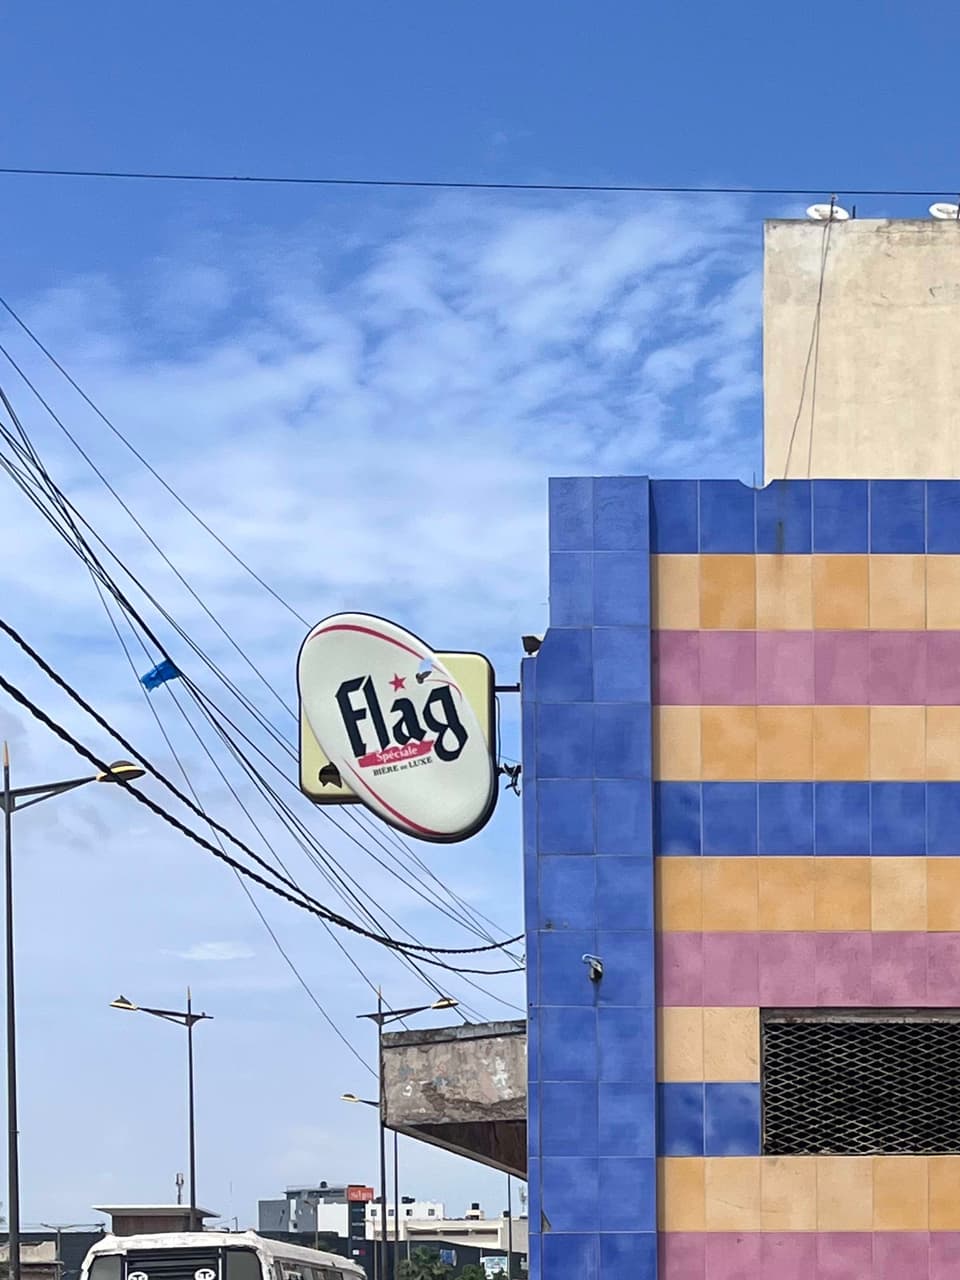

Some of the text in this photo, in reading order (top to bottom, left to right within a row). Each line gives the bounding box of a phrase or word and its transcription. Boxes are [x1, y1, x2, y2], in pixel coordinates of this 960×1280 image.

[335, 674, 468, 762] Flag
[376, 746, 418, 763] Spéciale
[373, 764, 399, 777] BIÈRE
[408, 756, 433, 769] LUXE
